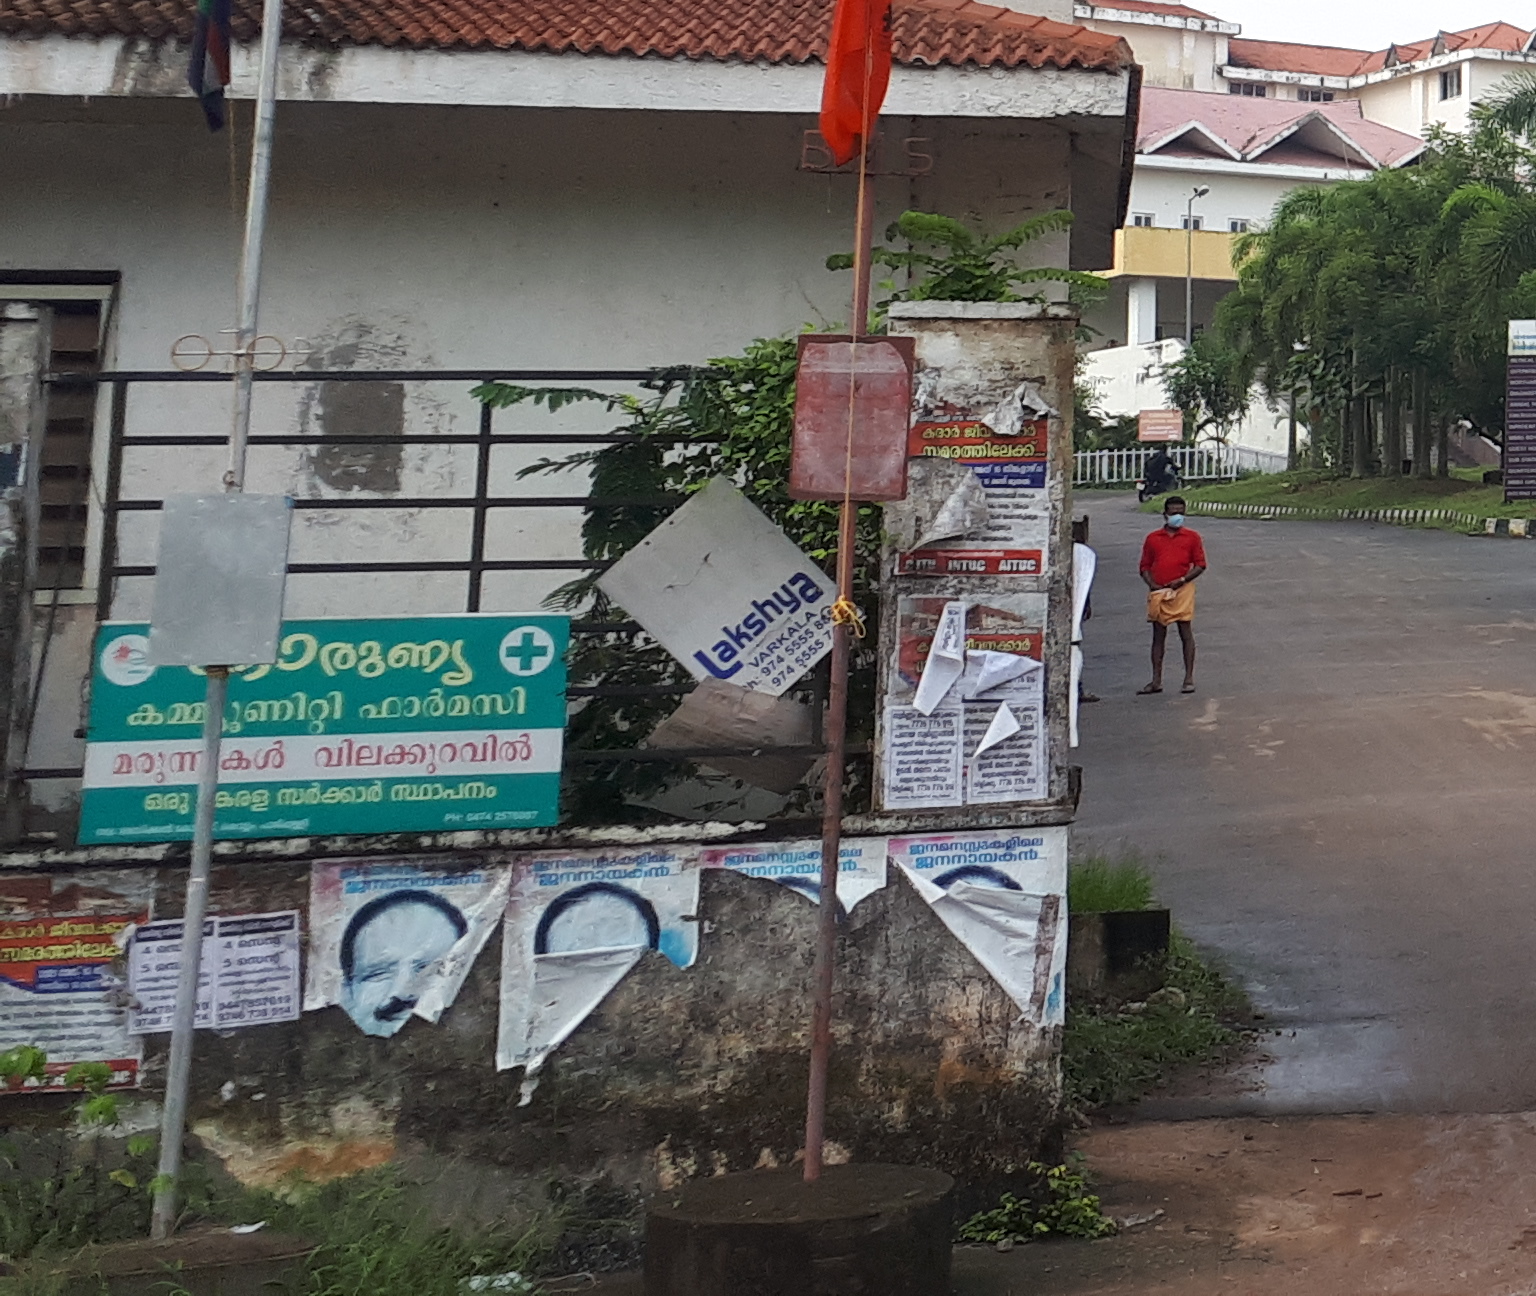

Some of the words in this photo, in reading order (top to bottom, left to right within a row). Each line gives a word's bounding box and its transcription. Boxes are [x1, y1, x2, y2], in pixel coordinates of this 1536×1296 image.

[801, 130, 934, 175] BS
[947, 559, 987, 572] INTUC
[997, 559, 1037, 572] AITUC
[693, 571, 824, 680] Lakshya
[748, 610, 818, 668] VARKALA
[761, 655, 786, 677] 974
[785, 628, 815, 656] 5555
[770, 666, 795, 688] 974
[795, 638, 825, 666] 5555
[358, 685, 527, 720] ഫാർമസി
[112, 740, 286, 784] മരുന്നകൾ
[314, 732, 533, 774] വിലക്കുറവിൽ
[276, 779, 383, 806] സർക്കാർ
